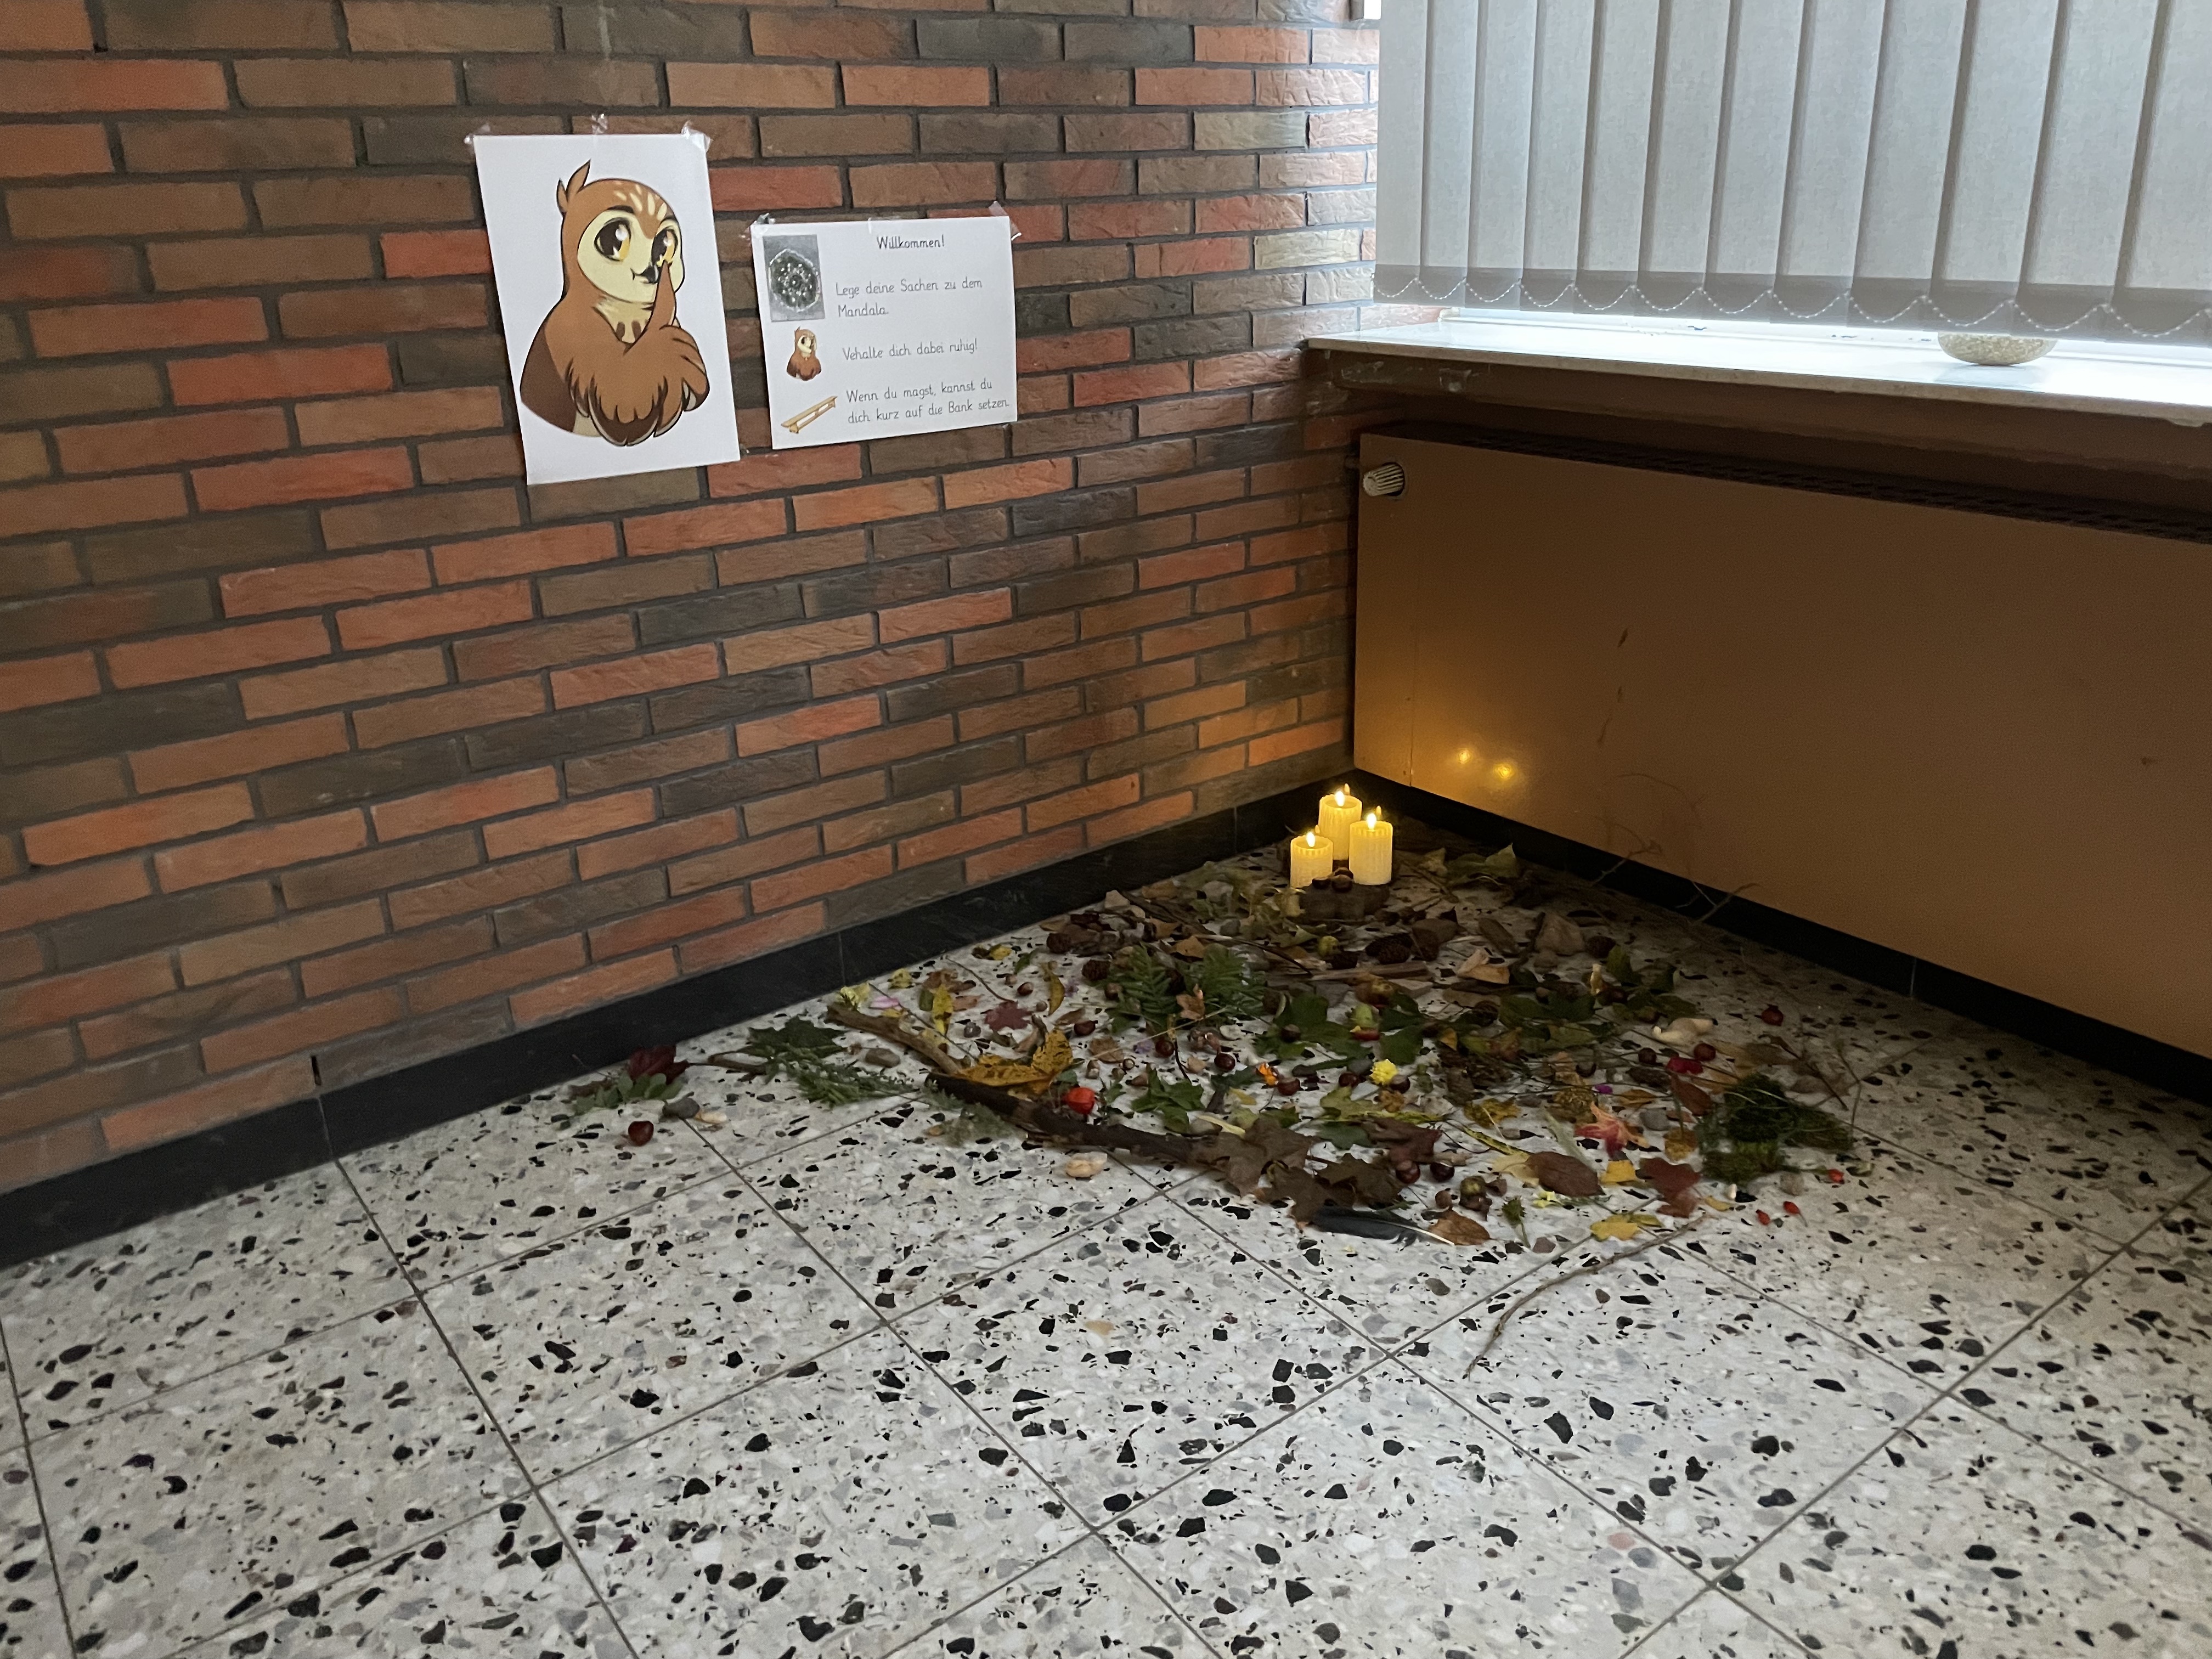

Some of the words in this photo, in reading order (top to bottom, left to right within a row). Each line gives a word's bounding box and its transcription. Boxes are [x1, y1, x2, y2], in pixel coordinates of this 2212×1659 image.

[876, 234, 945, 250] Willkommen!
[836, 282, 860, 299] Lege
[866, 280, 894, 294] deine
[900, 278, 939, 292] Sachen
[944, 281, 956, 290] zu
[962, 276, 983, 289] dem
[842, 345, 883, 360] Vehalte
[889, 343, 911, 357] dich
[916, 341, 945, 355] dabei
[950, 337, 978, 354] ruhig!
[846, 389, 878, 403] Wenn
[884, 386, 898, 400] du
[903, 383, 936, 400] magst,
[941, 380, 975, 393] kannst
[980, 377, 992, 390] du
[848, 410, 871, 424] dich
[876, 408, 900, 421] kurz
[905, 404, 923, 418] auf
[928, 403, 943, 415] die
[948, 399, 973, 414] Bank
